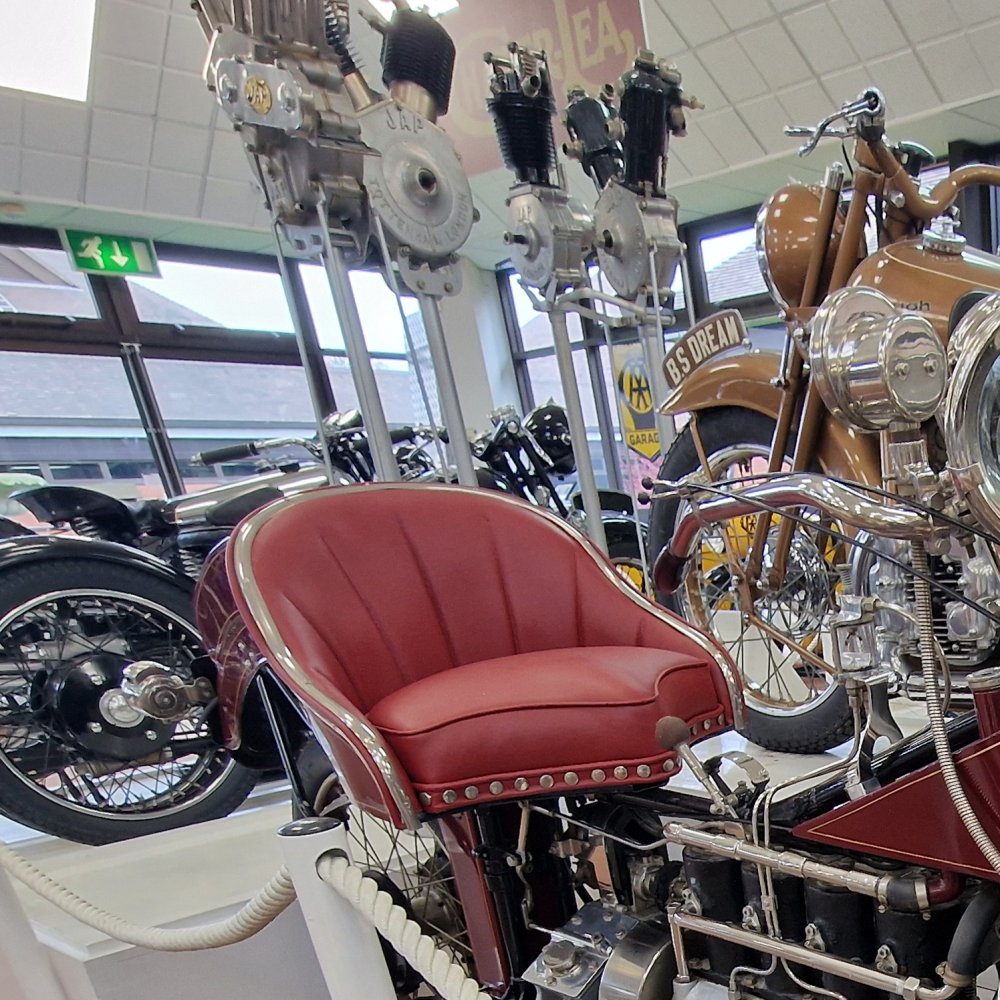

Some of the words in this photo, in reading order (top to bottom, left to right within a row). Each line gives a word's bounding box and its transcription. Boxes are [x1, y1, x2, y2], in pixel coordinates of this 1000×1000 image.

[385, 108, 424, 135] JAP
[665, 346, 691, 386] B.S
[687, 316, 740, 364] DREAM
[629, 432, 659, 446] GARAG
